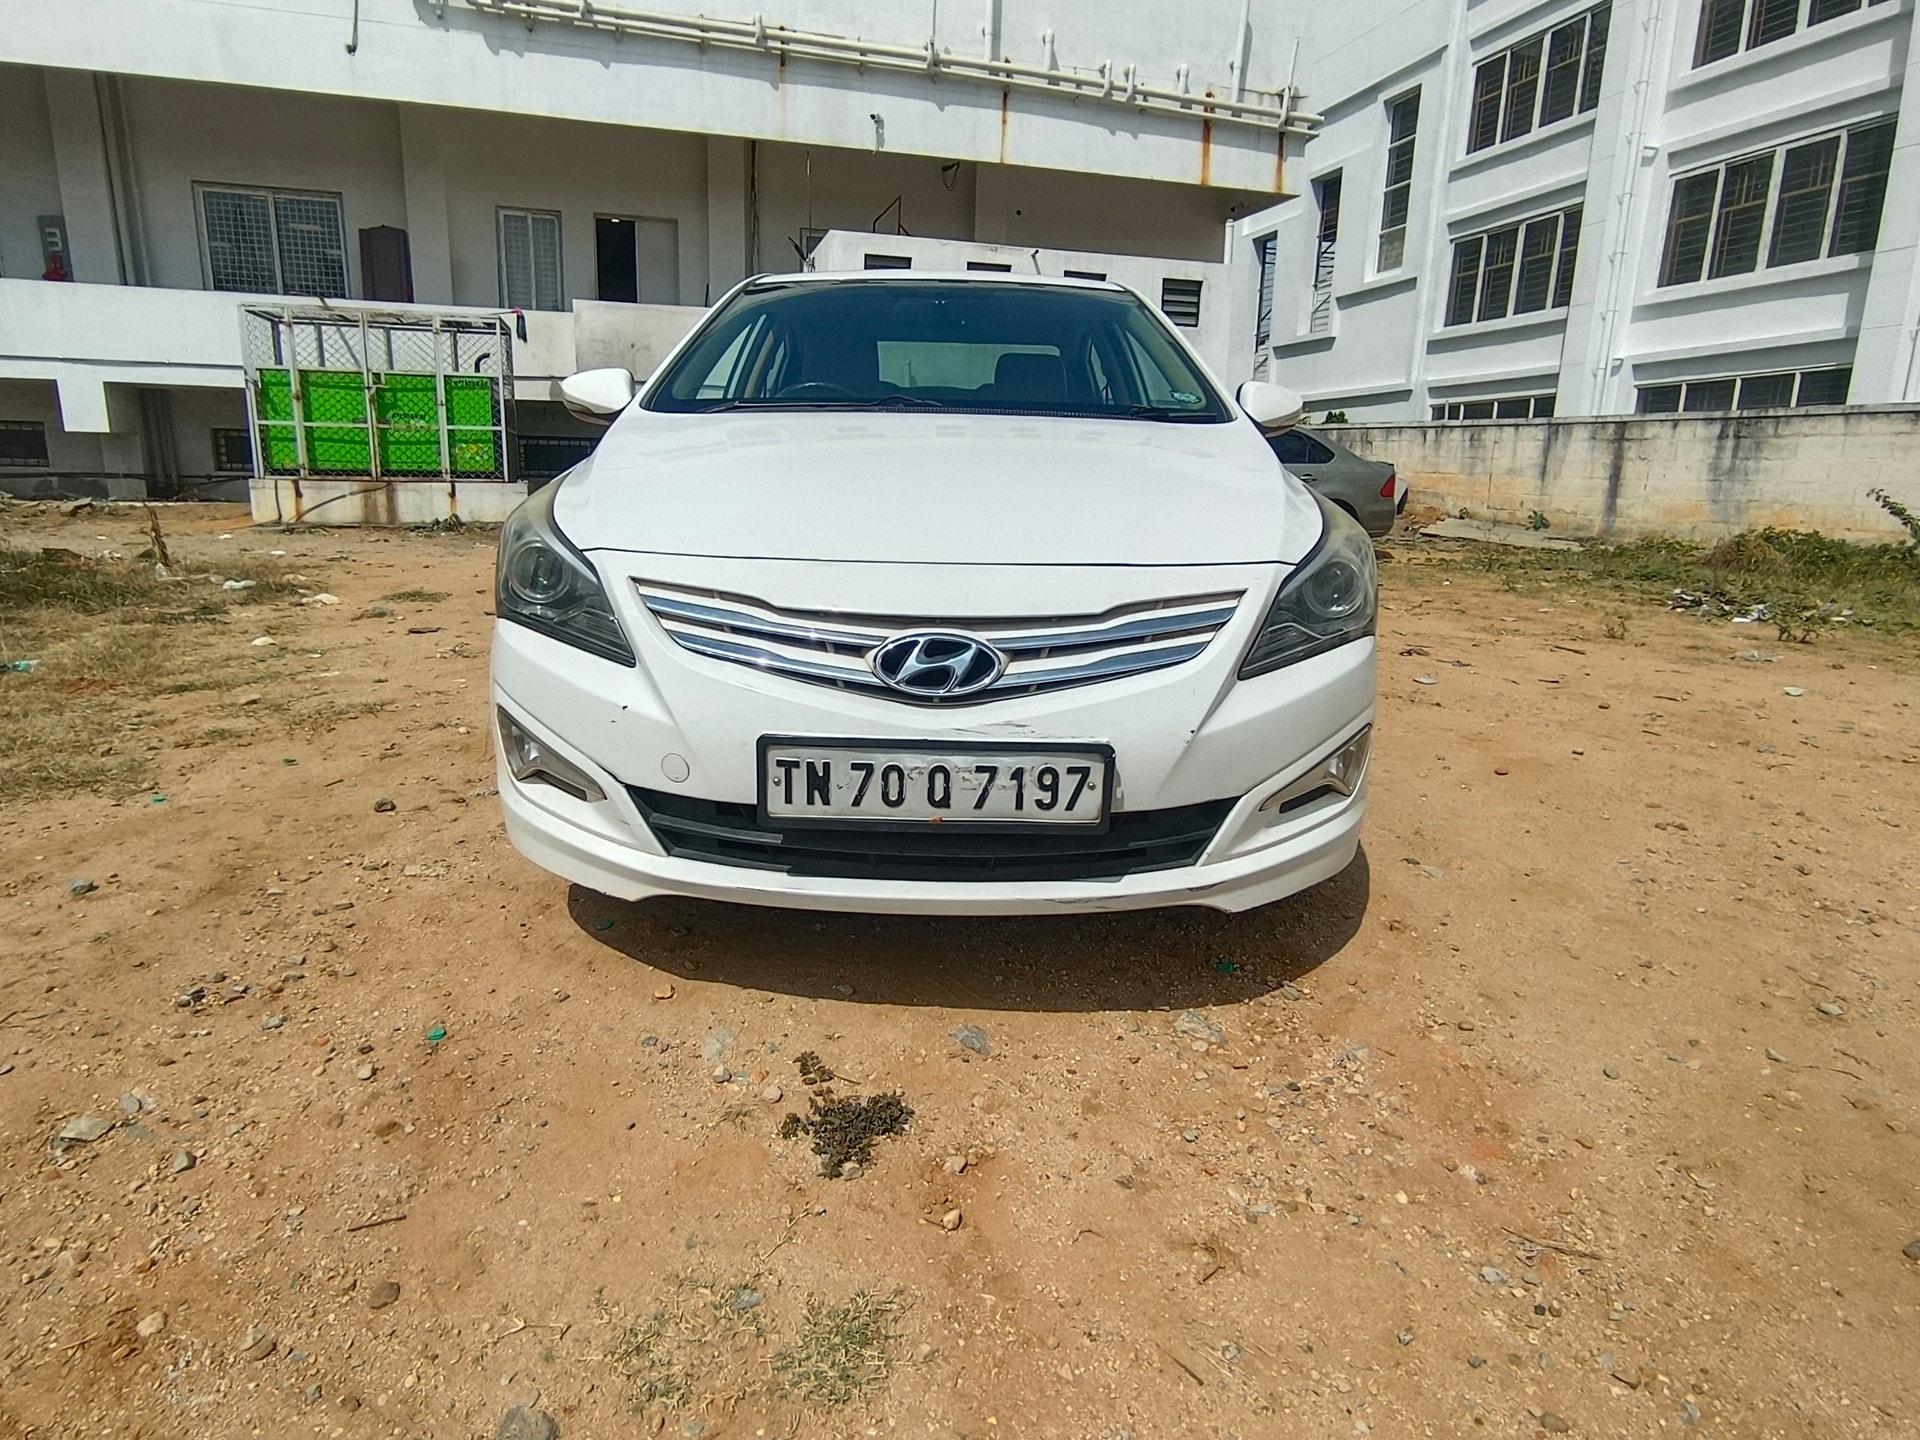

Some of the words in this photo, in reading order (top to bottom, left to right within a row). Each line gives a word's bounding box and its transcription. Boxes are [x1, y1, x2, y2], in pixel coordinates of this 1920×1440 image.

[776, 759, 831, 806] TN
[850, 762, 905, 808] 70
[927, 764, 951, 809] Q
[973, 766, 1092, 812] 7197
